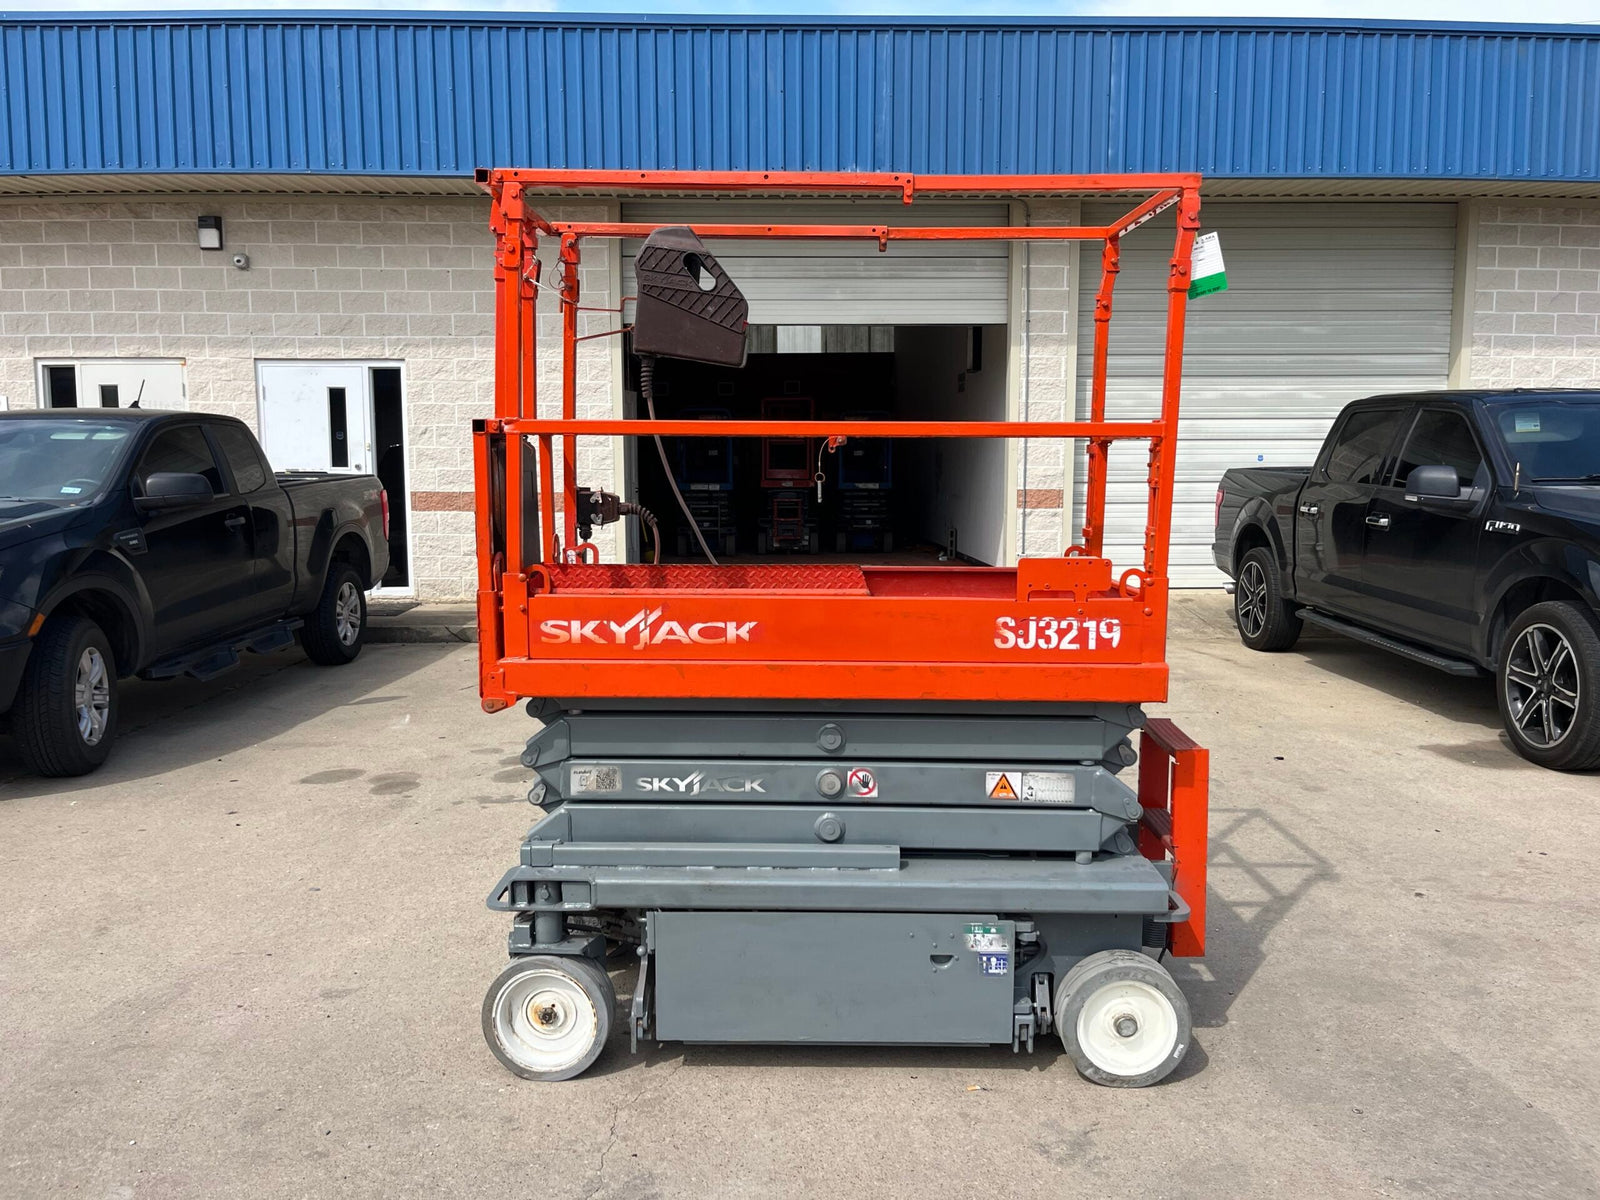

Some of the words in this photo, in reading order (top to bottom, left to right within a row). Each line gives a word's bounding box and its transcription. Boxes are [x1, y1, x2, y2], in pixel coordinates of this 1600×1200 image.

[539, 606, 758, 650] SKYJACK
[993, 616, 1121, 650] SJ3219
[635, 769, 767, 797] SKYJACK
